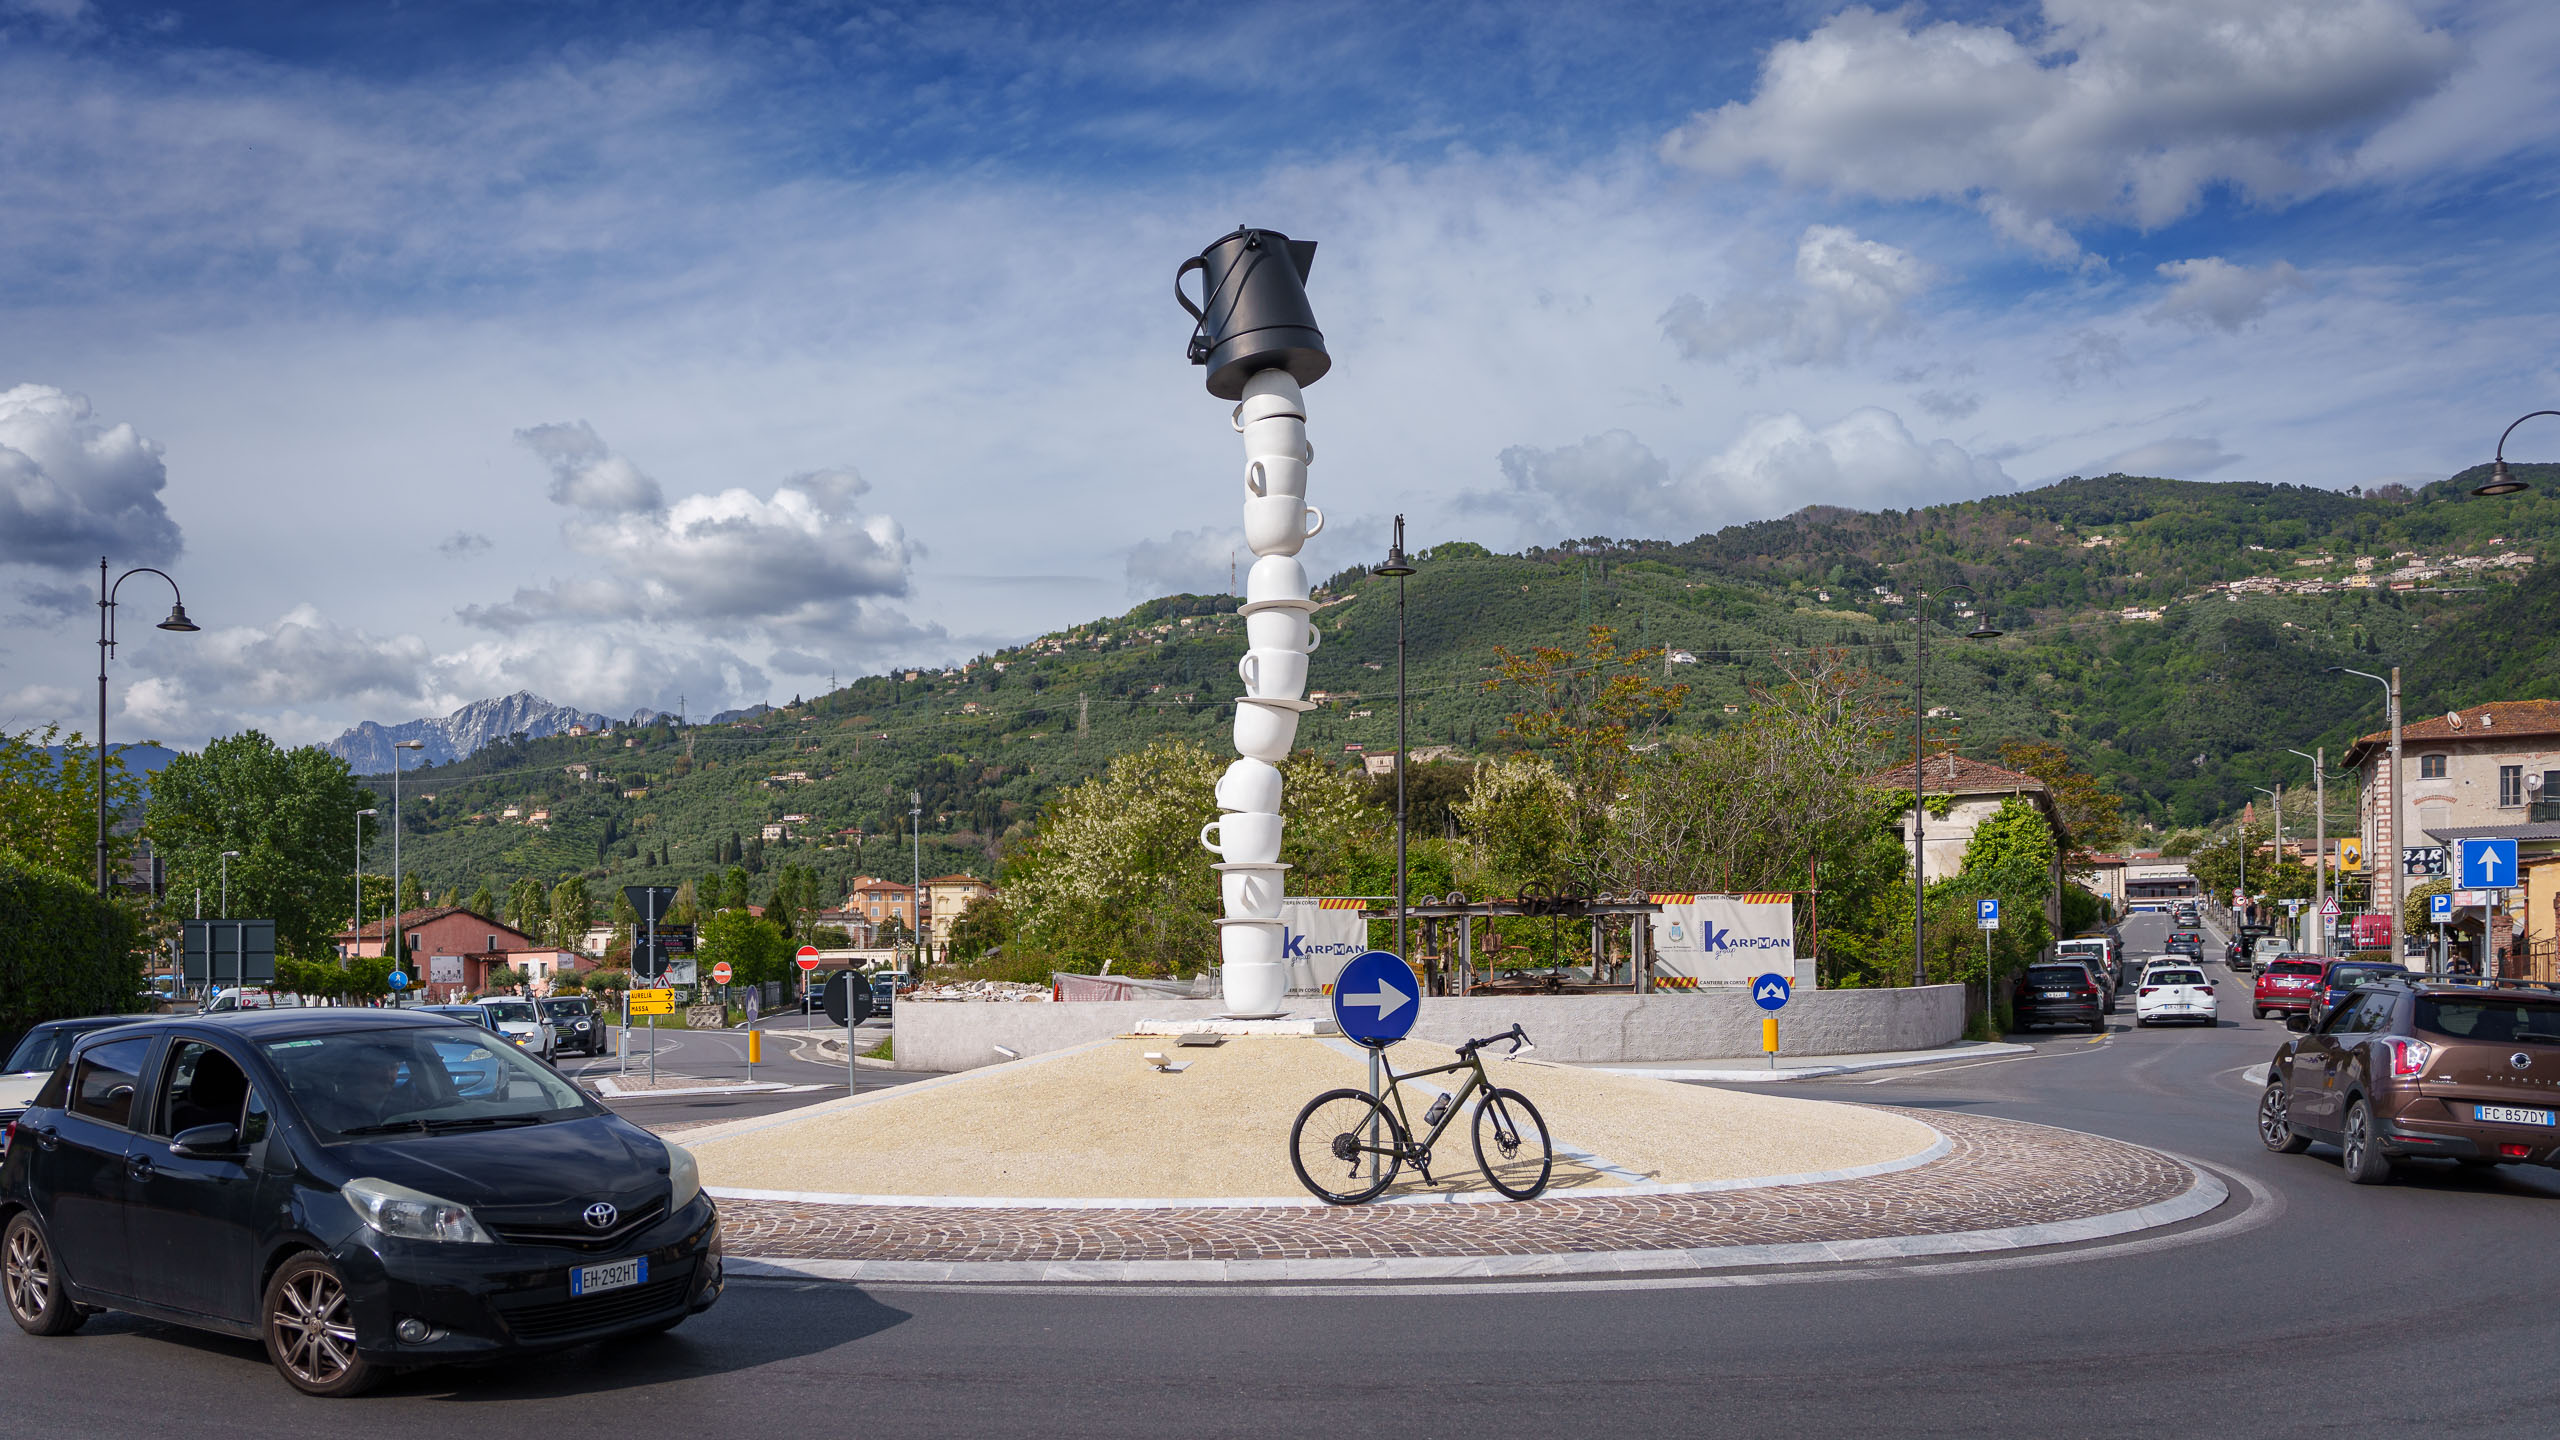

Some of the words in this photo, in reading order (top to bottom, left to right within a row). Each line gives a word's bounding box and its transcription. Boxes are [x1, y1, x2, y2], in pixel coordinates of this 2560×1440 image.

[2402, 849, 2443, 861] BAR
[1981, 902, 1994, 917] P
[2434, 896, 2447, 911] P
